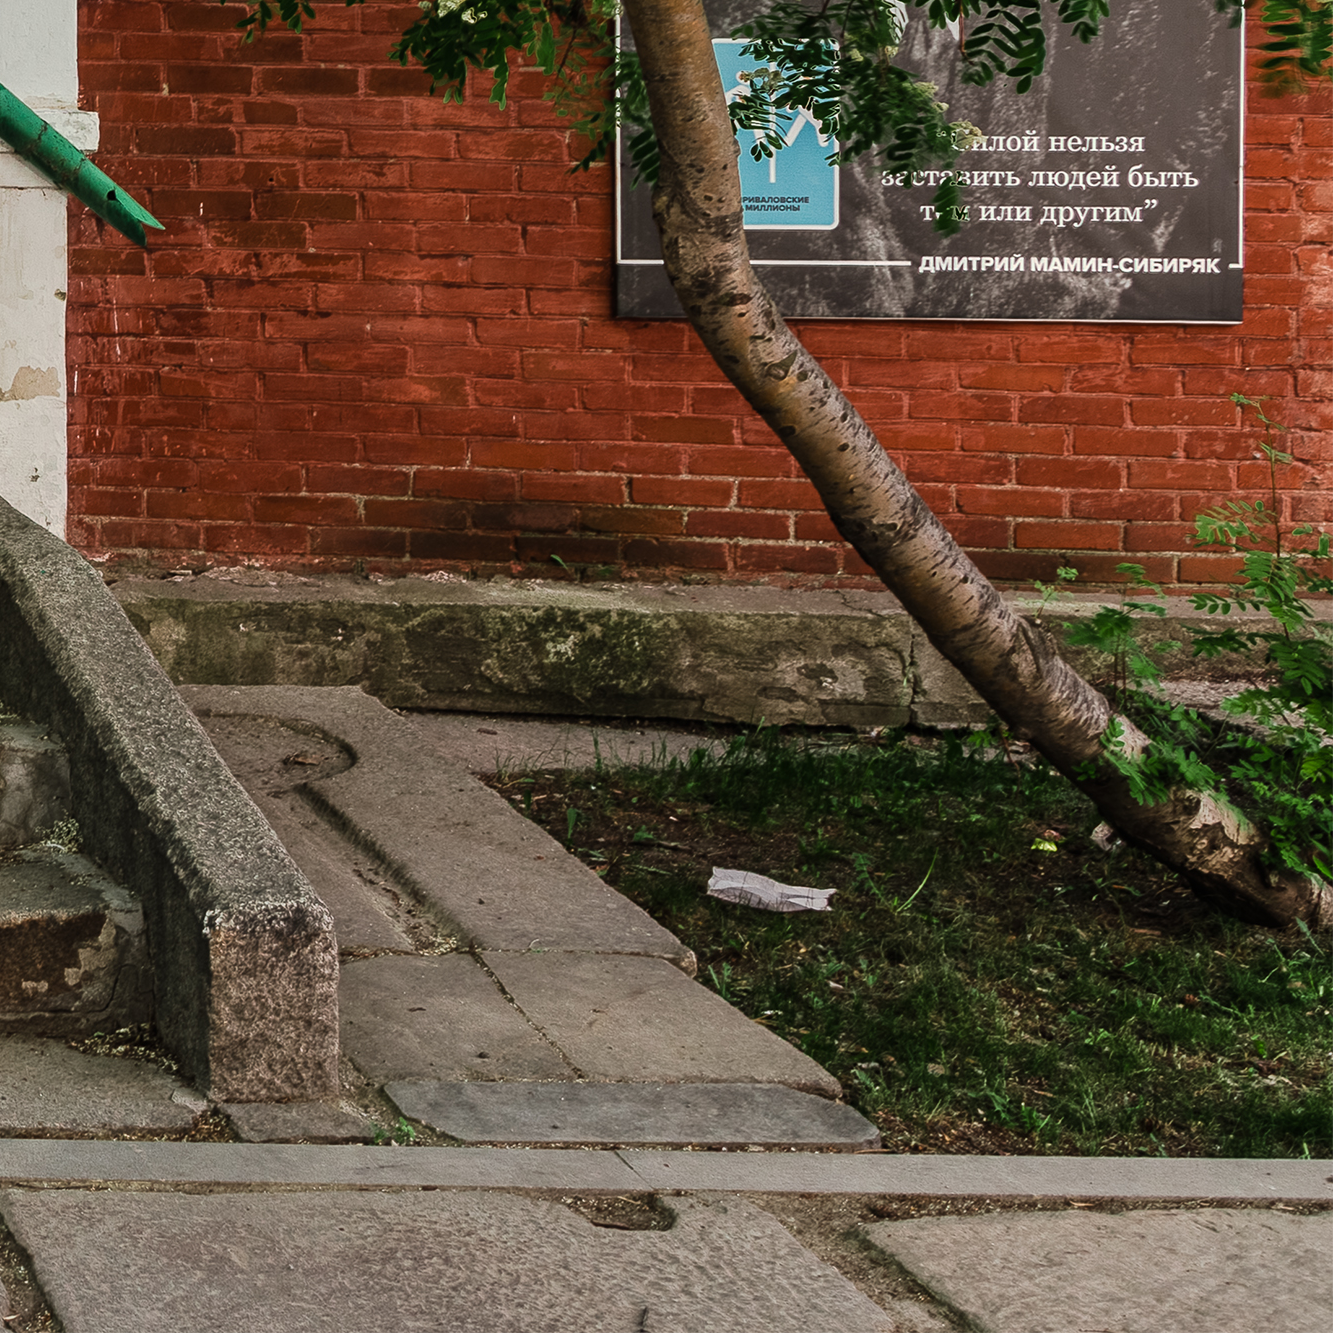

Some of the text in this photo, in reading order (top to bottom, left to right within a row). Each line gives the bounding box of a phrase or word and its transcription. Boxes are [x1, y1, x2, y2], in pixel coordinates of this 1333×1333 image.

[1048, 133, 1145, 153] нельзя
[1027, 165, 1121, 191] людей
[1127, 164, 1199, 188] быть
[742, 196, 810, 204] РИВАЛОВСКИЕ
[745, 204, 801, 212] МИЛЛИОНЫ
[979, 204, 1032, 223] или
[918, 253, 1222, 274] ДМИТРИЙ МАМИН-СИБИРЯК
